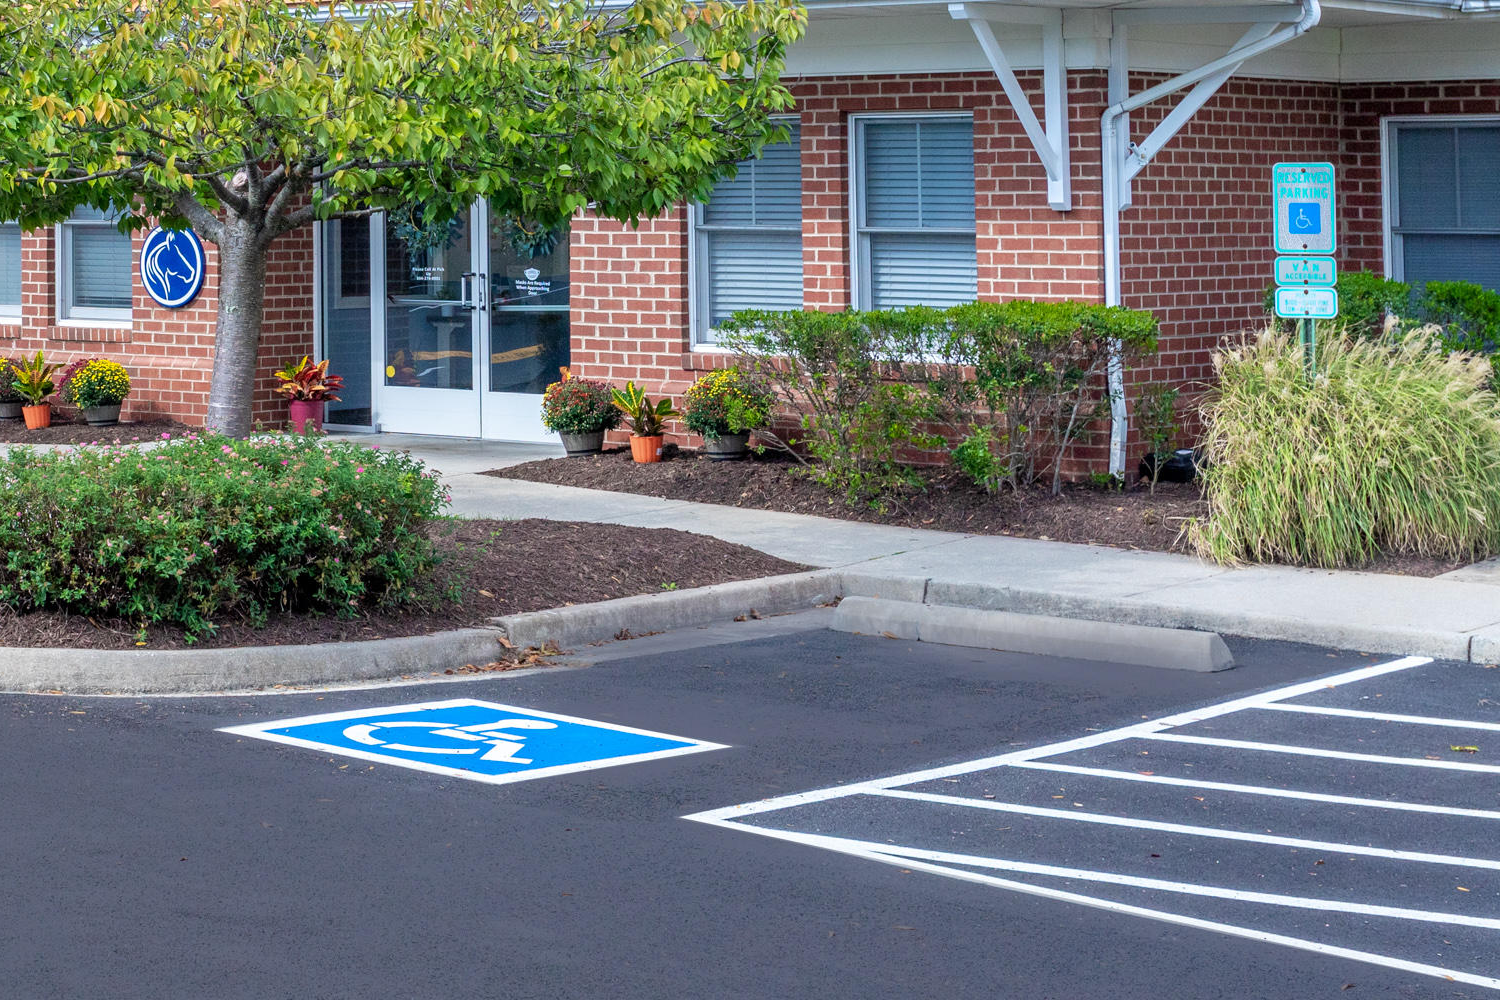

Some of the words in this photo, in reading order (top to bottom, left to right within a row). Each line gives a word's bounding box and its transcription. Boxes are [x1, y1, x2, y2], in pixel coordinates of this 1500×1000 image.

[1277, 171, 1330, 184] RESERVED
[1280, 187, 1329, 199] PARKING
[1292, 263, 1320, 272] VAN
